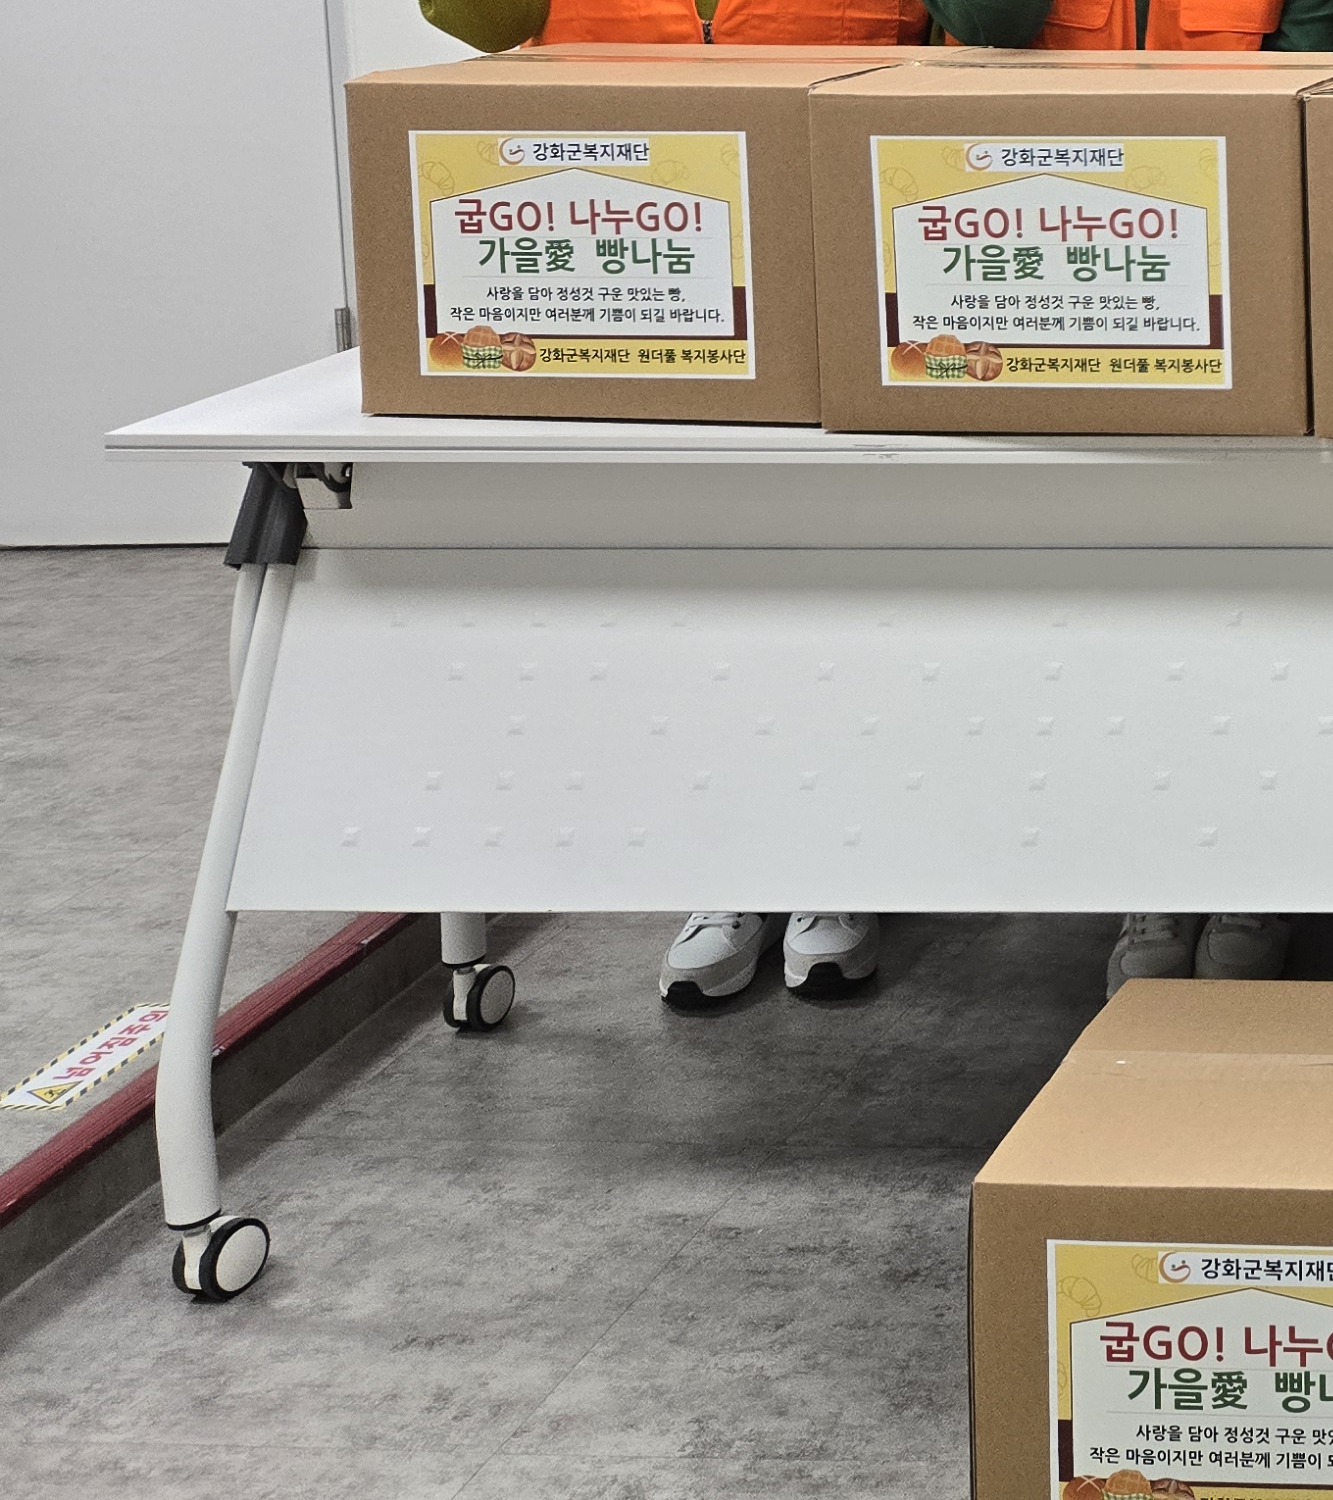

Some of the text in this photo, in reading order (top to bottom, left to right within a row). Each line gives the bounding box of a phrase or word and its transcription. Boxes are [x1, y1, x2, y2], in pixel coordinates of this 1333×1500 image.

[533, 141, 649, 162] 강화군복지재단
[1002, 145, 1124, 168] 강화군복지재단
[454, 198, 702, 236] 굽GO! 나누GO!
[918, 205, 1178, 243] 굽GO! 나누GO!
[478, 236, 696, 275] 가을愛 빵나눔
[942, 244, 1171, 283] 가을愛 빵나눔
[540, 348, 746, 365] 강화군복지재단 원더풀 복지봉사단
[1006, 357, 1222, 374] 강화군복지재단 원더풀 복지봉사단
[1100, 1321, 1224, 1366] 굽GO!
[1128, 1366, 1248, 1412] 가을愛
[1136, 1423, 1181, 1442] 사랑을
[1188, 1425, 1217, 1443] 담아
[1274, 1427, 1306, 1445] 구운
[1090, 1447, 1120, 1464] 작은
[1125, 1447, 1202, 1467] 마음이지만
[1208, 1450, 1271, 1468] 여러분께
[1275, 1452, 1322, 1469] 기쁨이
